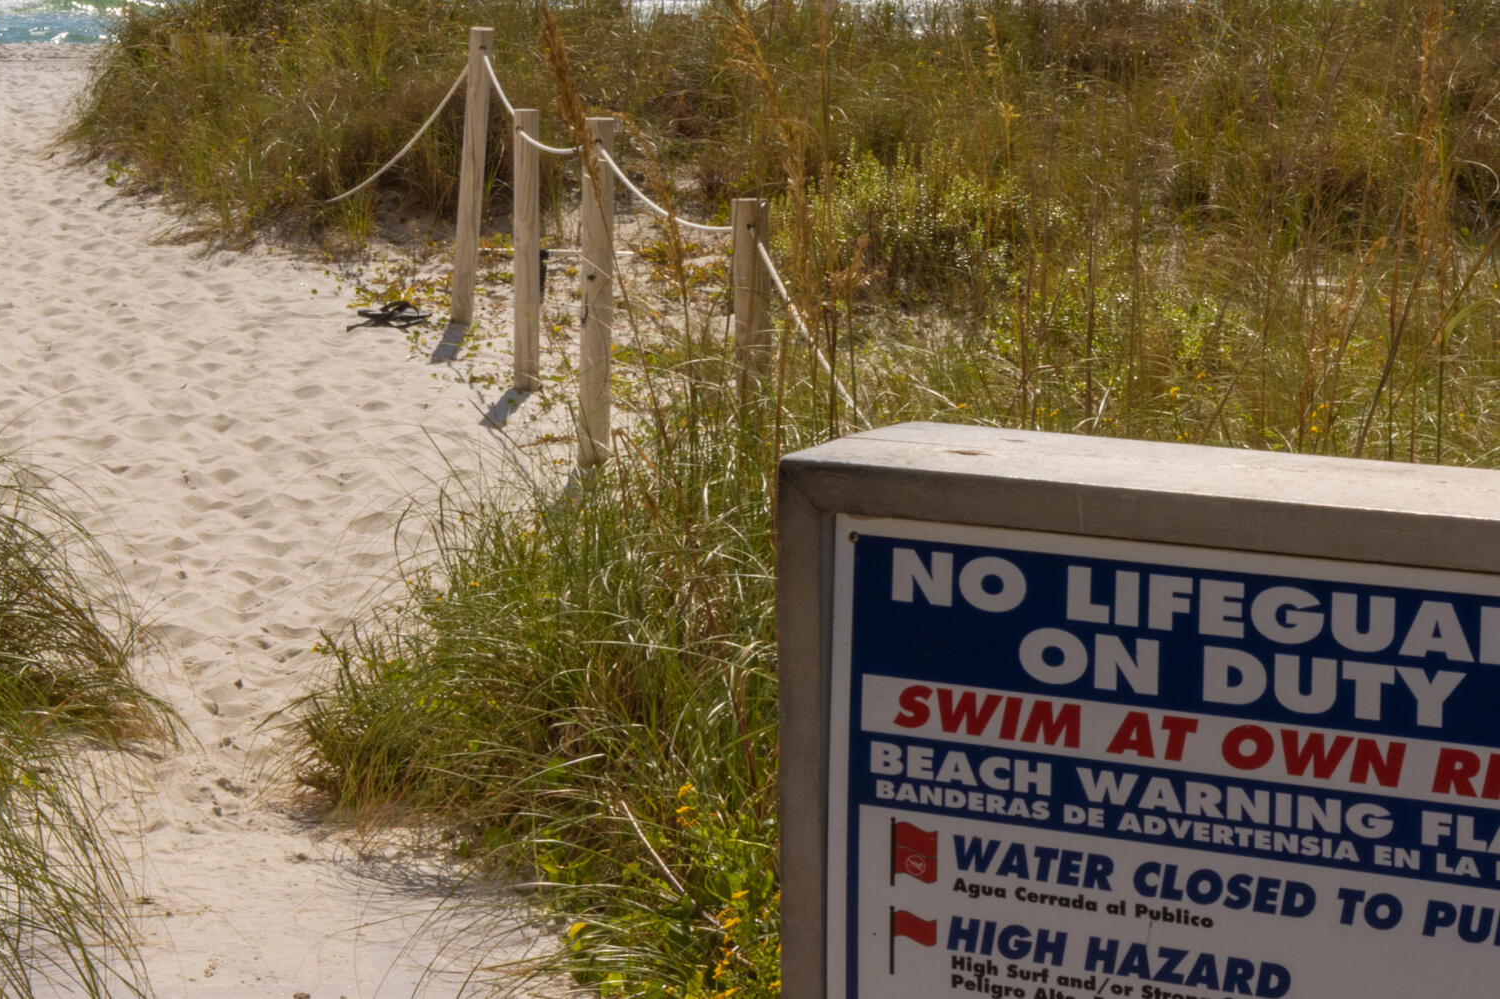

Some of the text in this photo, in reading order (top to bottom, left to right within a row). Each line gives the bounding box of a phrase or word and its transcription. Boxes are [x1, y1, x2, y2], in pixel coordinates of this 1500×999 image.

[891, 547, 1027, 613] NO
[1018, 627, 1467, 728] ON DUTY
[893, 684, 1081, 749] SWIM
[1105, 711, 1199, 762] AT
[1221, 724, 1407, 788] OWN
[870, 740, 1052, 796] BEACH
[1076, 766, 1394, 839] WARNING
[875, 779, 1050, 821] BANDERAS
[1063, 804, 1105, 828] DE
[1117, 812, 1360, 862] ADVERTENSIA
[1374, 844, 1421, 870] EN
[1436, 852, 1481, 879] LA
[952, 877, 1214, 929] Agua Cerrada al Publico
[953, 834, 1500, 950] WATER CLOSED TO PU
[946, 915, 1294, 999] HIGH HAZARD
[951, 955, 999, 978] High
[1007, 964, 1050, 984] Surf
[1057, 975, 1134, 997] and/or
[951, 974, 1026, 999] Peligro
